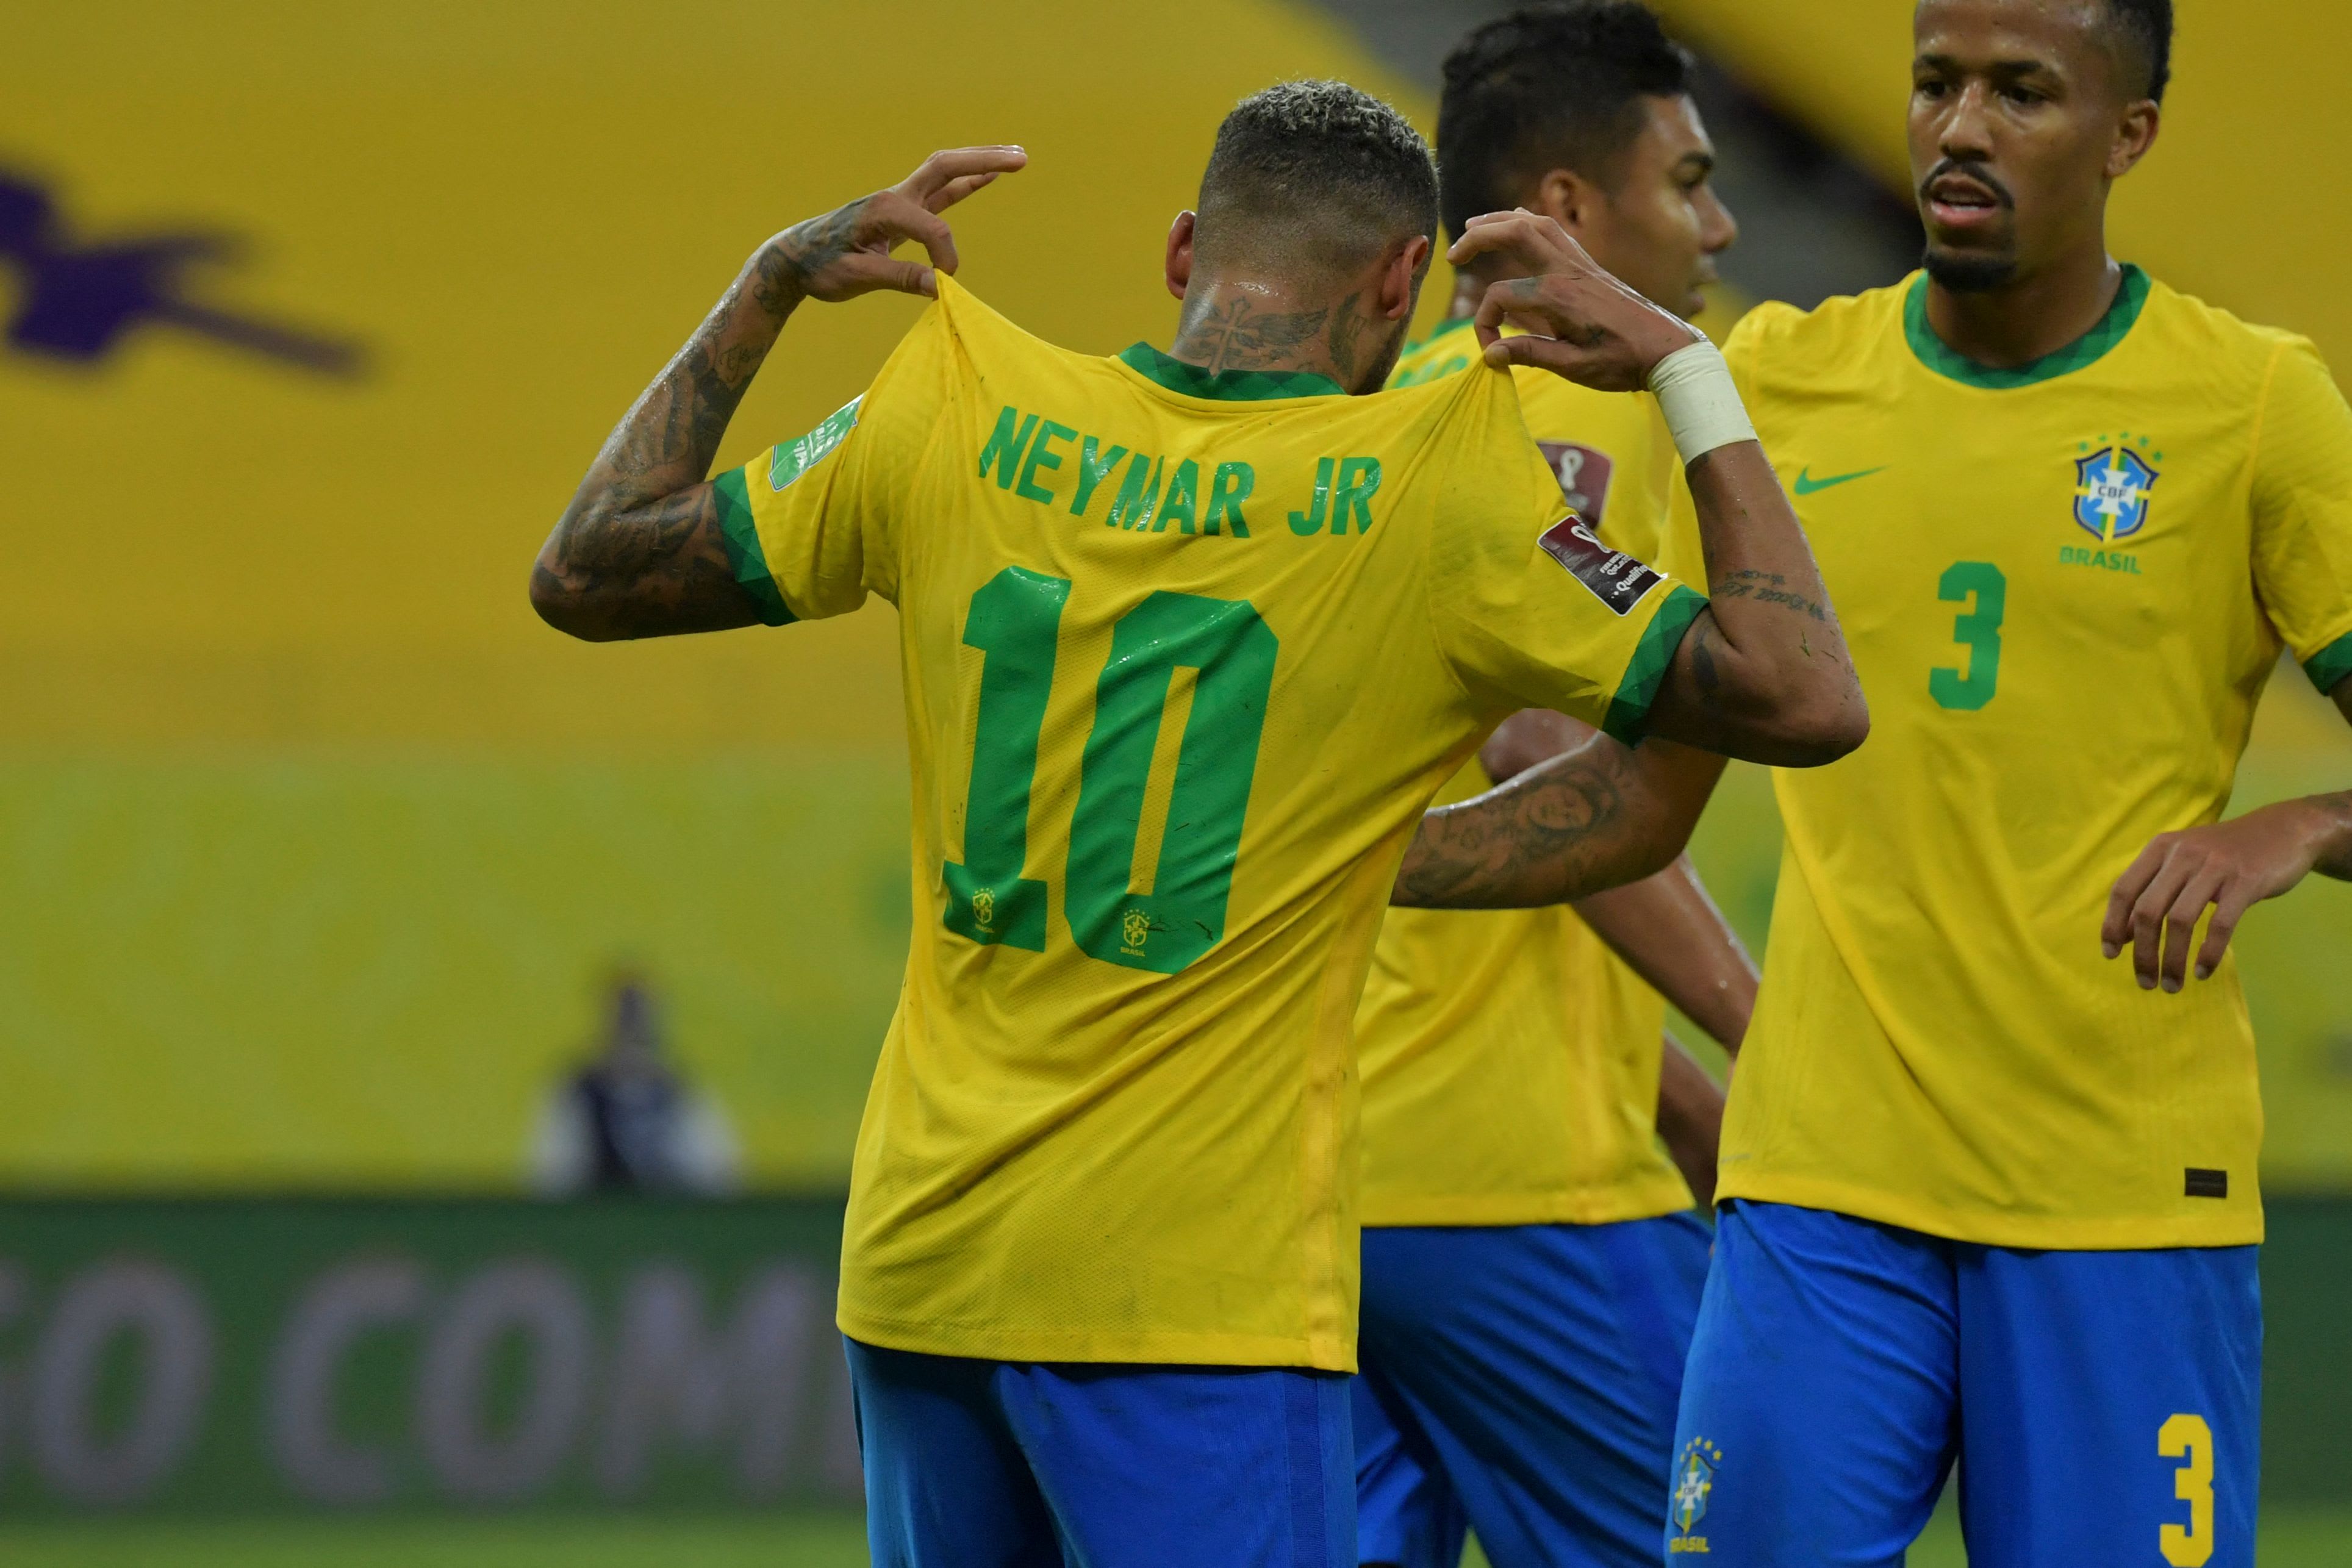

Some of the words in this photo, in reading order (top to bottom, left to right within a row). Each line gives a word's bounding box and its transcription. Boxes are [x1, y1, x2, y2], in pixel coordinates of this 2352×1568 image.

[978, 406, 1255, 539] NEYMAR
[1287, 456, 1382, 537] JR
[2098, 485, 2127, 498] CBF
[2060, 546, 2142, 575] BRASIL
[1929, 560, 2006, 711] 3
[943, 565, 1280, 976] 10
[1120, 946, 1146, 957] BRASIL
[2158, 1413, 2214, 1568] 3
